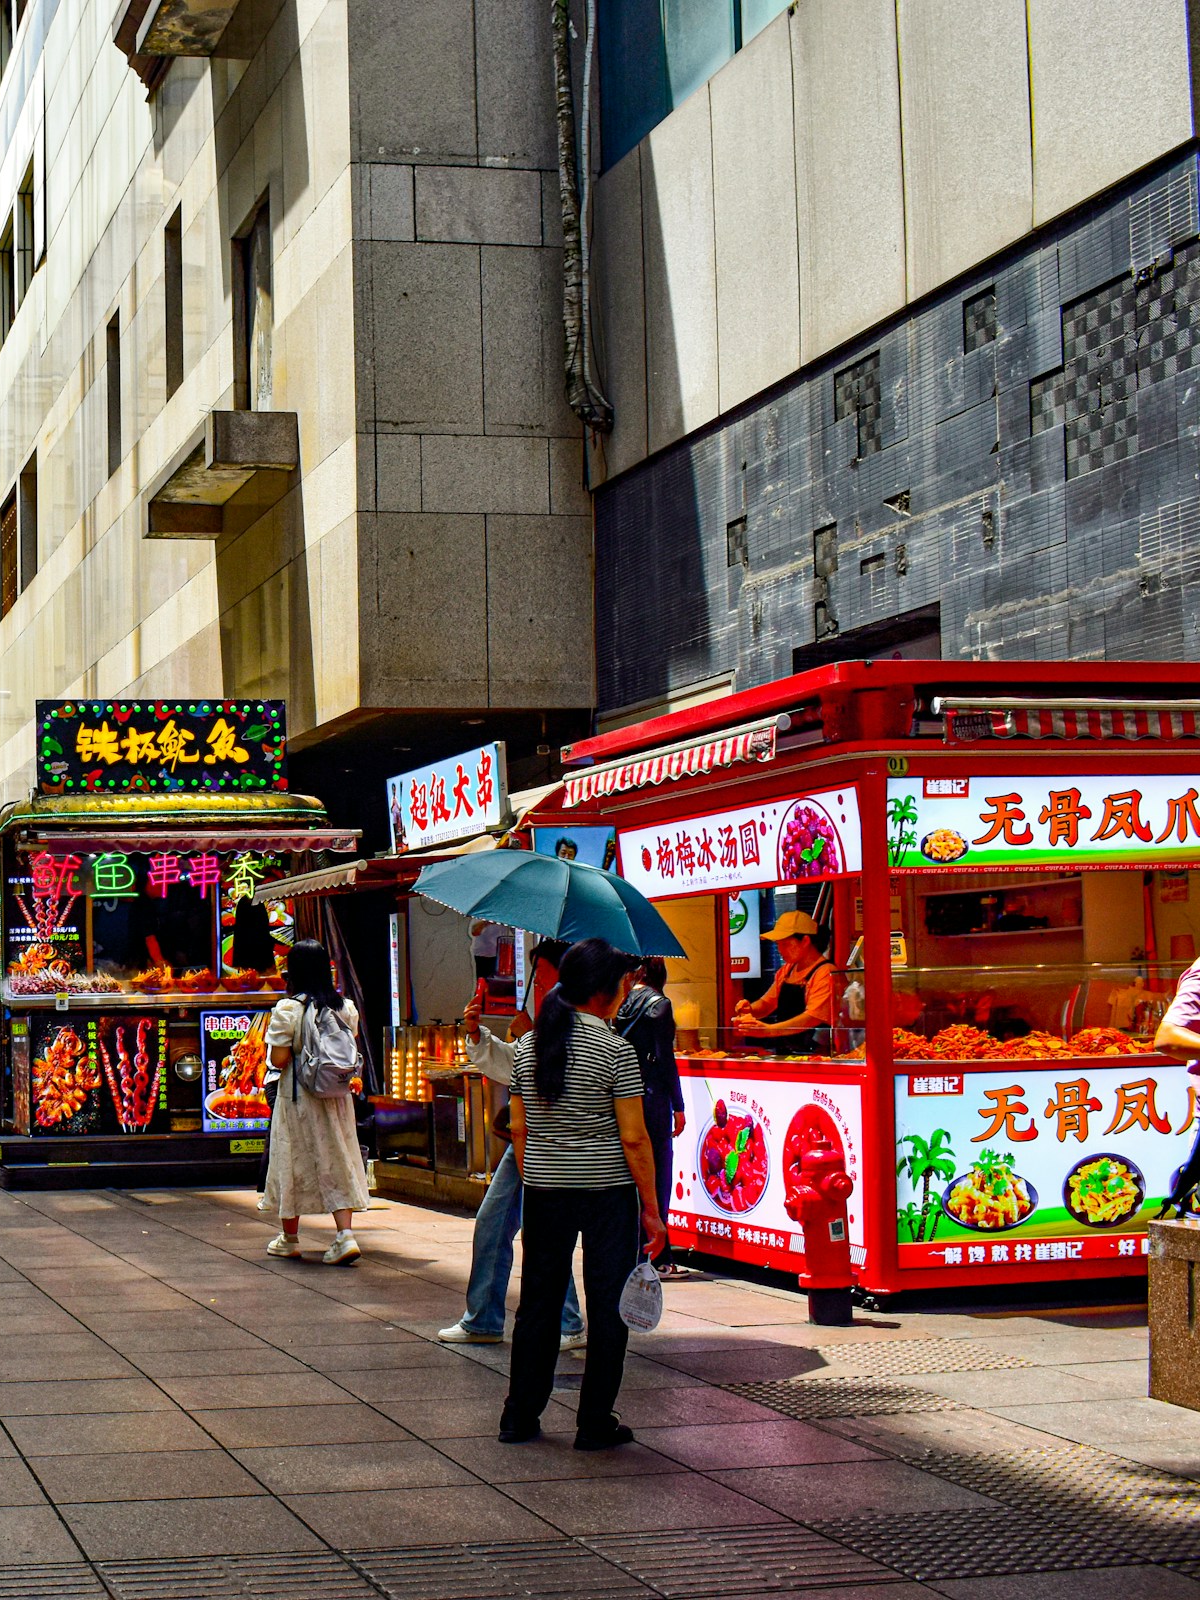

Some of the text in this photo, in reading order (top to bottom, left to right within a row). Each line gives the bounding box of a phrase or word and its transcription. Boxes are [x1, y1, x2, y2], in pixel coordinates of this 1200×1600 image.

[75, 718, 250, 774] 铁板鱿鱼
[889, 758, 905, 771] 01
[409, 748, 494, 831] 超级大串
[972, 787, 1200, 846] 无骨凤爪
[656, 818, 761, 878] 杨梅冰汤圆
[31, 852, 264, 899] 鱿鱼串串香
[205, 1016, 250, 1031] 串串香
[696, 1218, 732, 1238] 吃了还想吃
